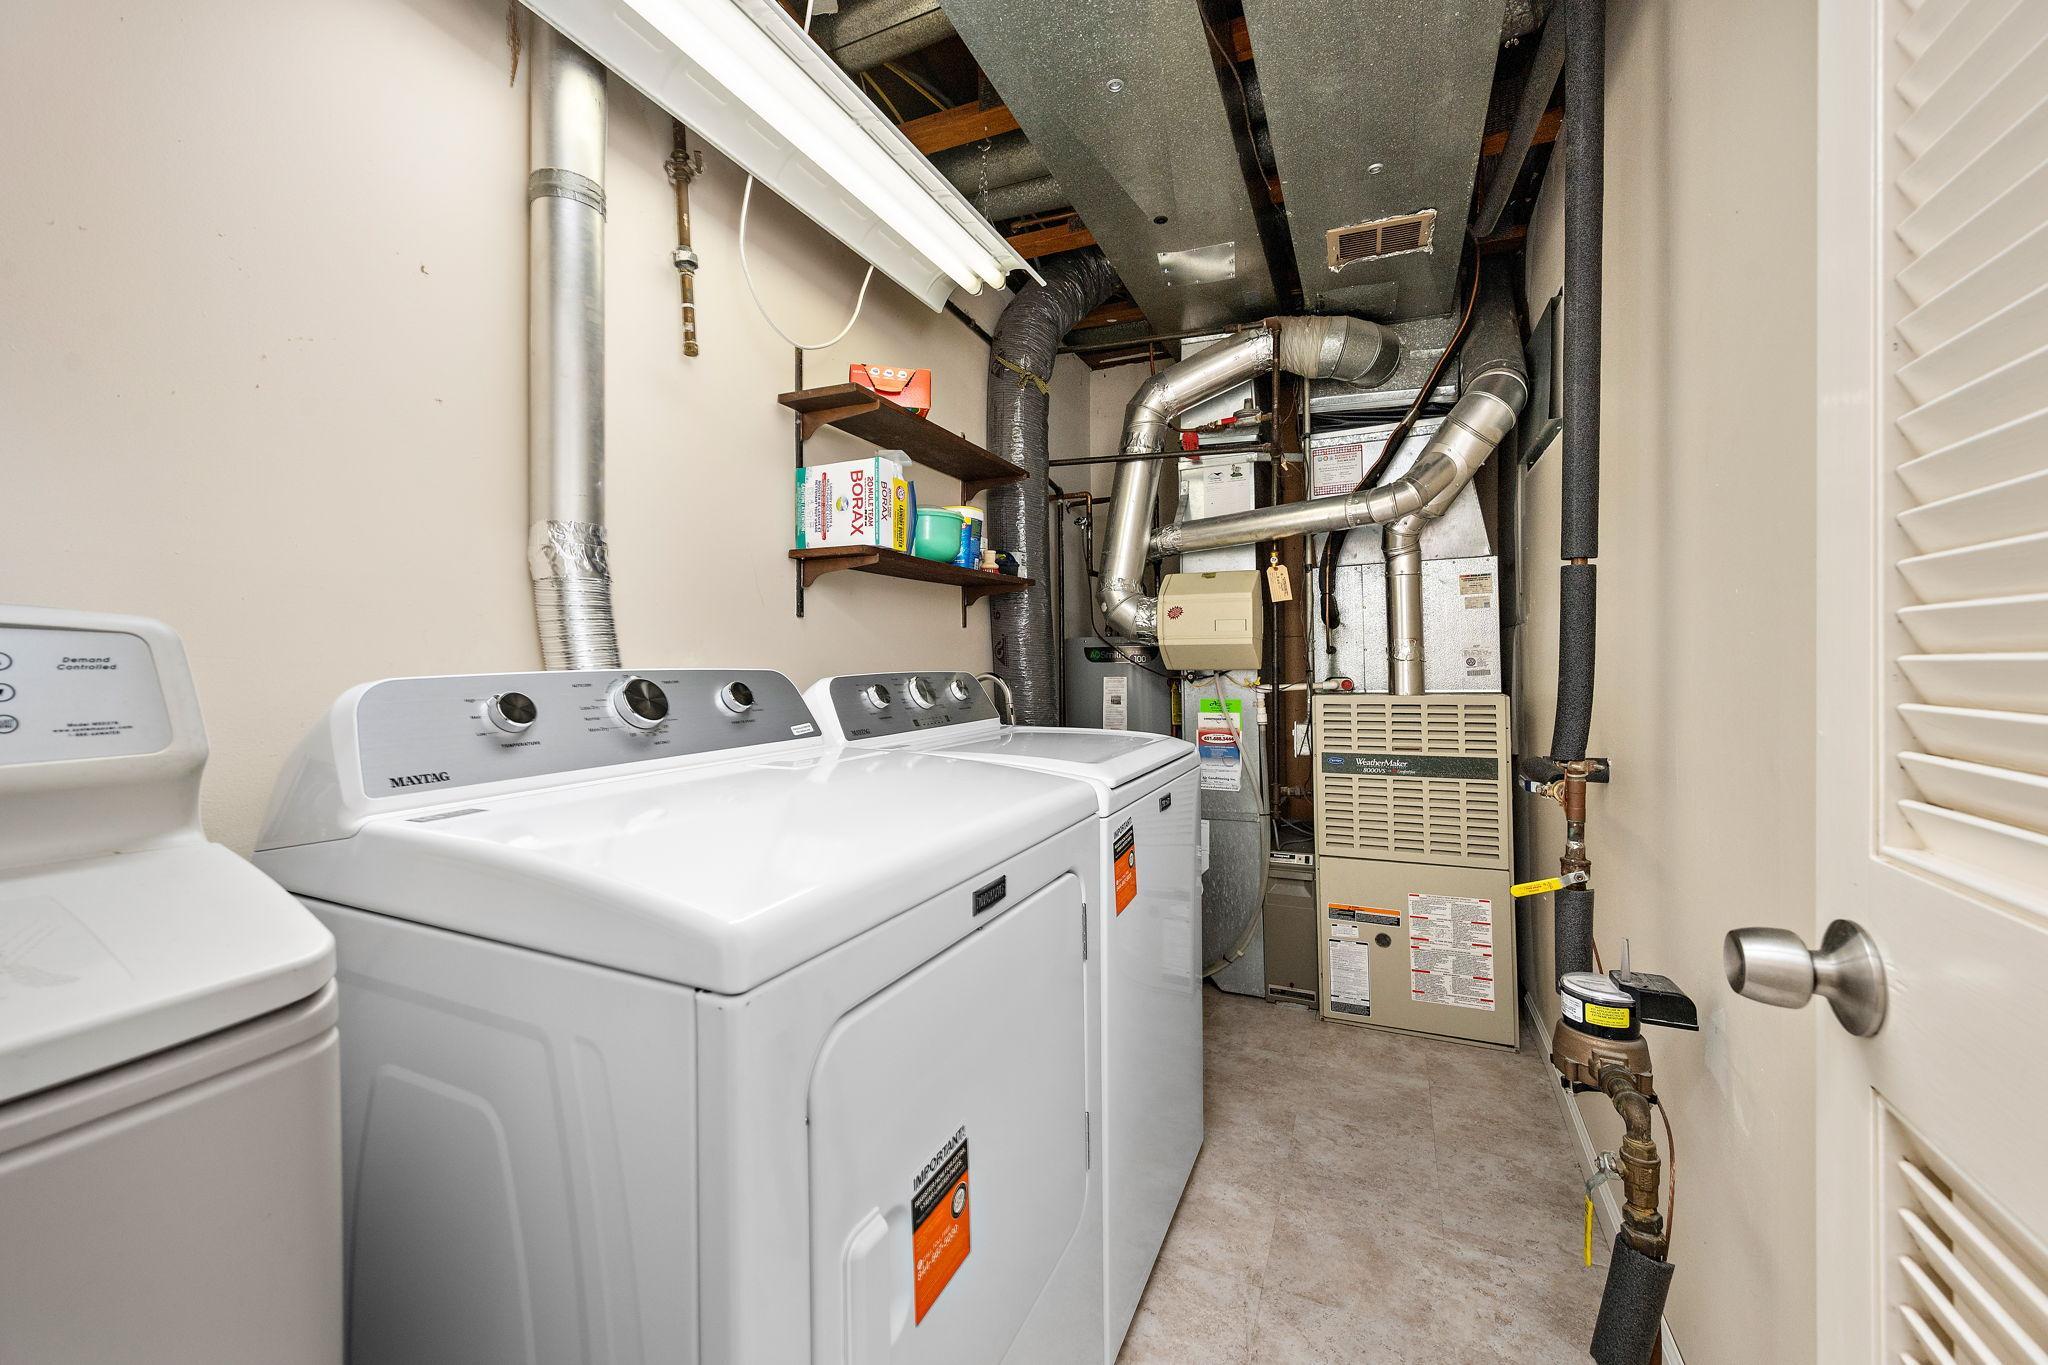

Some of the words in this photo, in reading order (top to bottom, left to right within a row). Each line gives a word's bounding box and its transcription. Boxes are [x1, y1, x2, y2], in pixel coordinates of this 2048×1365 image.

[867, 476, 873, 487] 20
[850, 470, 864, 536] BORAX
[1355, 757, 1408, 767] WeatherMaker
[389, 771, 451, 788] MAYTAG
